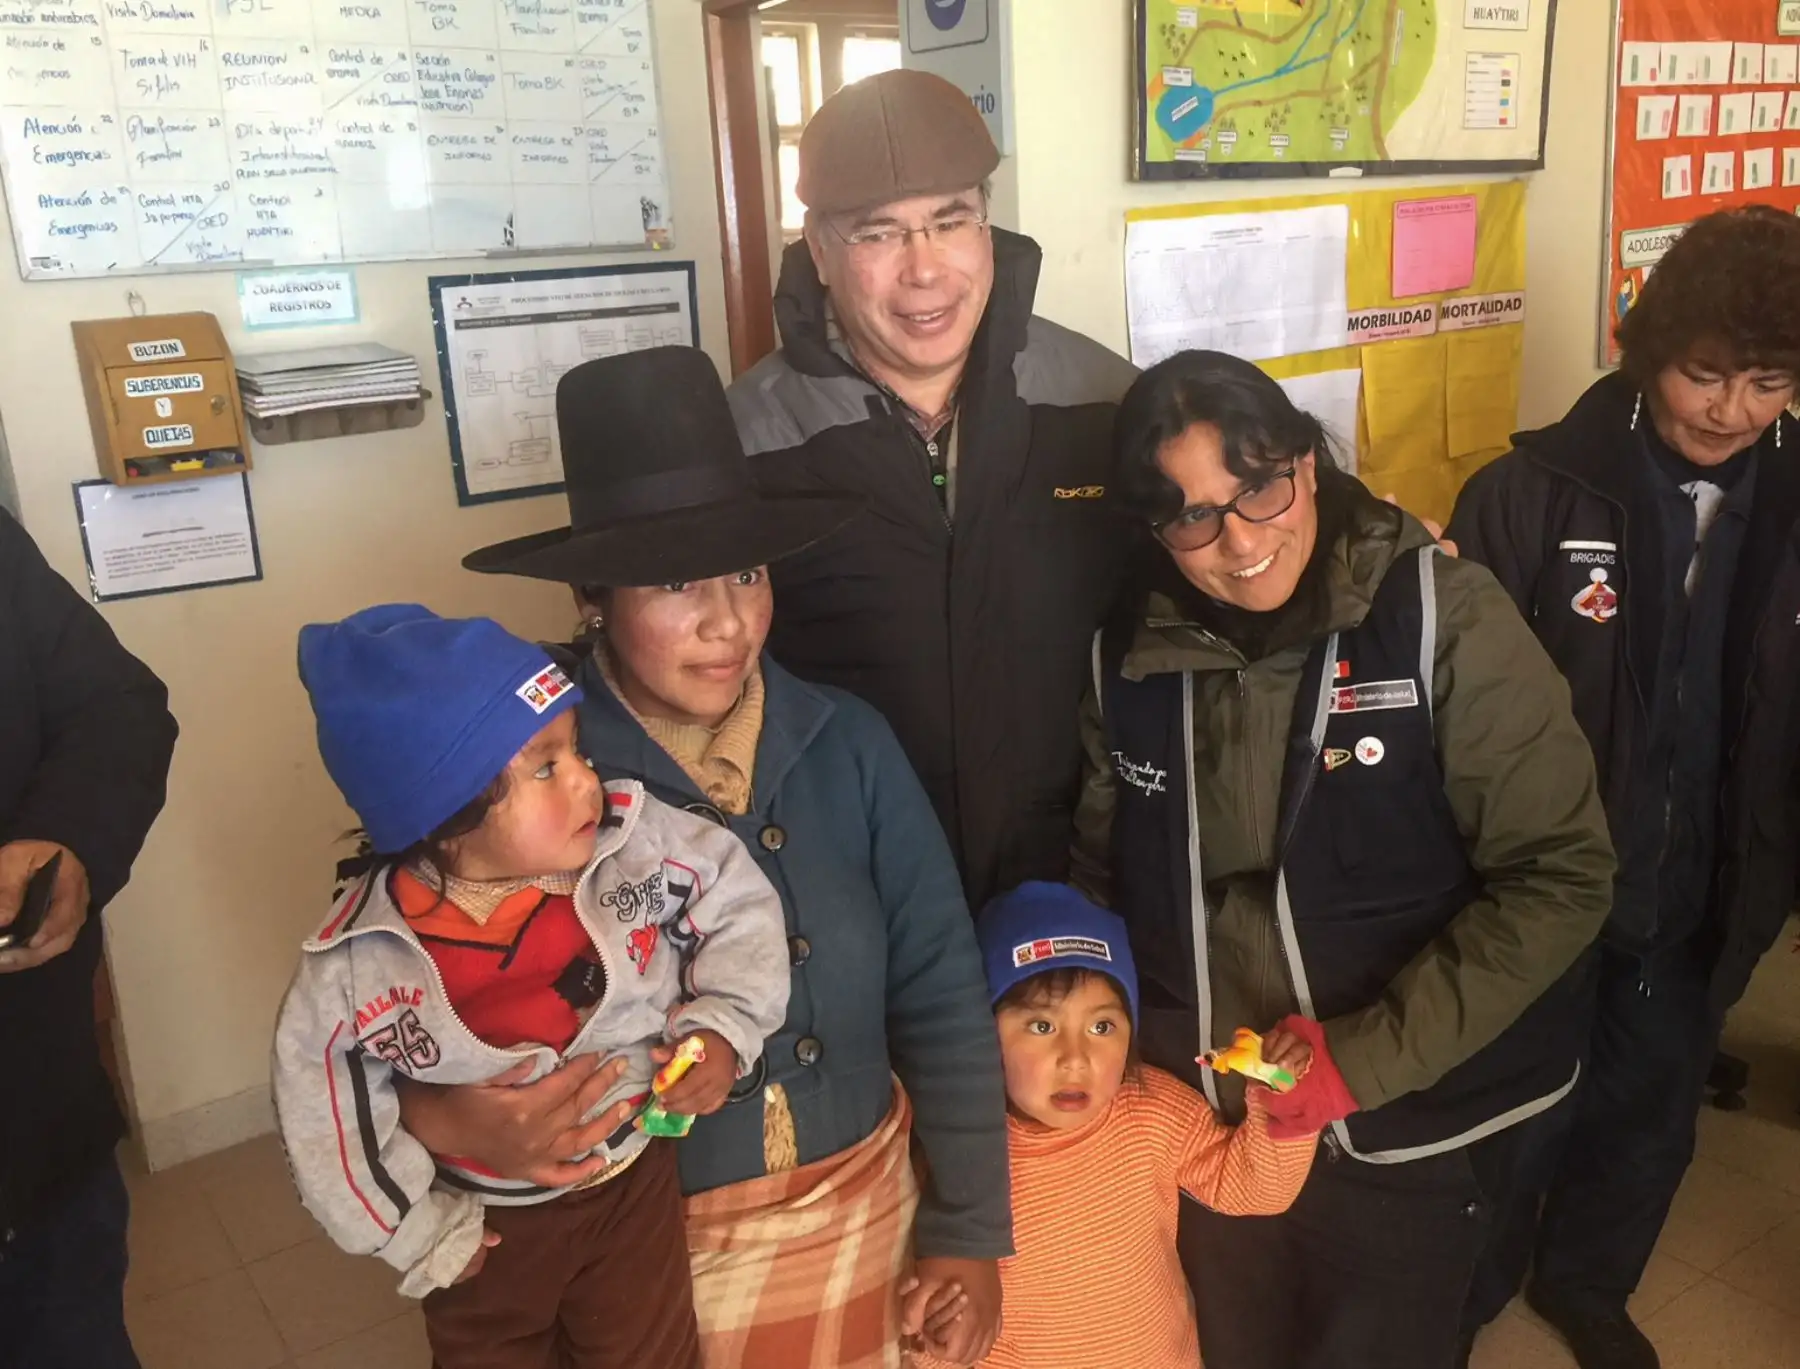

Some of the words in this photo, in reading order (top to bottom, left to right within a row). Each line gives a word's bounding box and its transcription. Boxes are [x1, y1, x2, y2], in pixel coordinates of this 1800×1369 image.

[252, 280, 325, 296] CUADERNOS
[326, 279, 343, 291] DE
[268, 299, 333, 313] REGISTROS
[1440, 297, 1523, 319] MORTALIDAD
[1346, 308, 1433, 332] MORBILIDAD
[133, 341, 180, 357] BUZON
[126, 375, 201, 394] SUGERENCIAS
[157, 400, 167, 414] Y
[144, 426, 192, 444] QUEJAS
